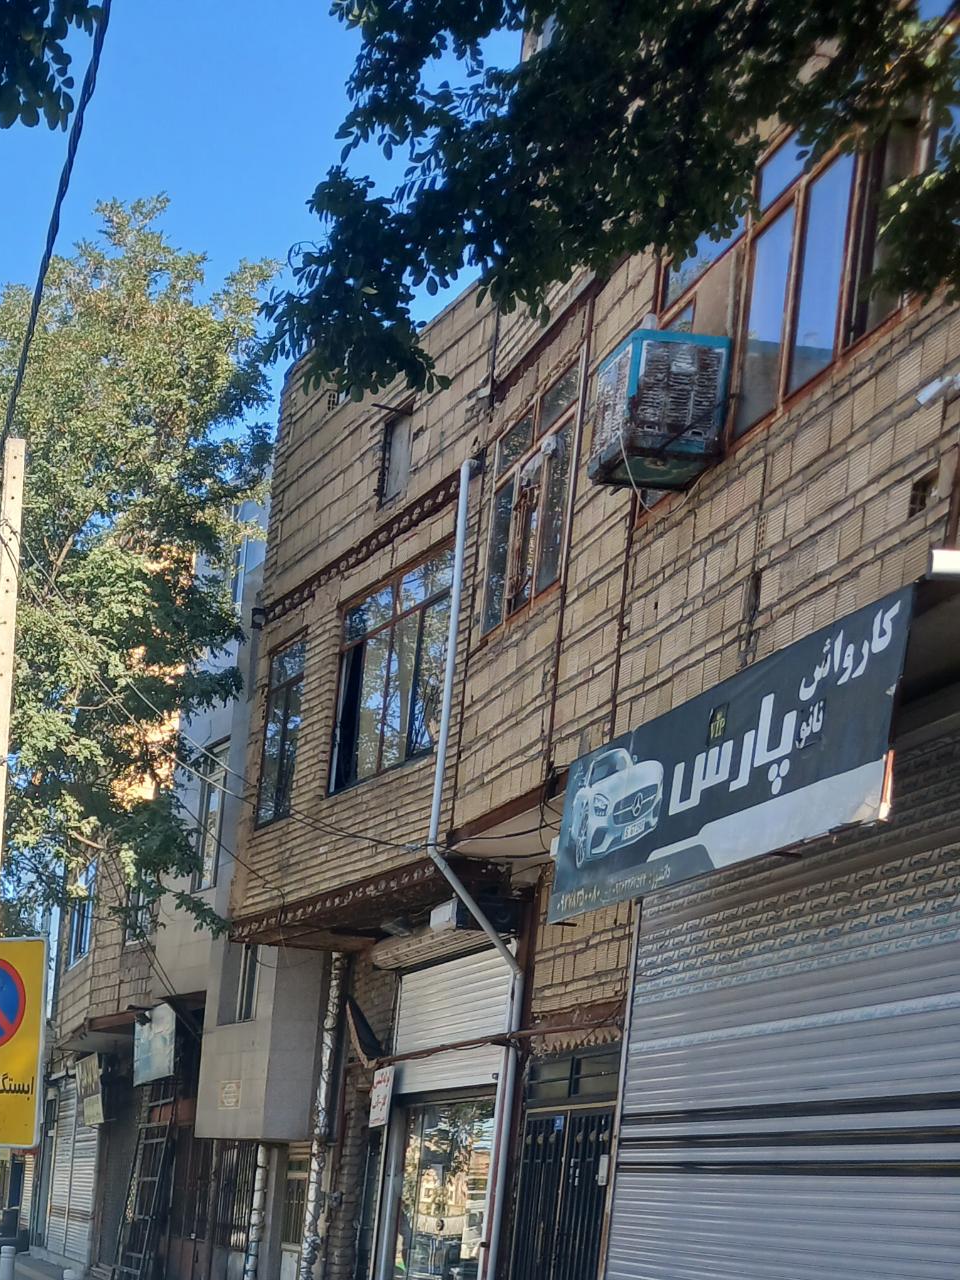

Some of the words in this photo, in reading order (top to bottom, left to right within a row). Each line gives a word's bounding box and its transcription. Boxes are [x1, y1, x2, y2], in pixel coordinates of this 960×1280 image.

[799, 600, 901, 701] کارواش
[669, 693, 797, 815] پارس
[710, 719, 726, 739] VIP
[795, 701, 824, 749] نانو
